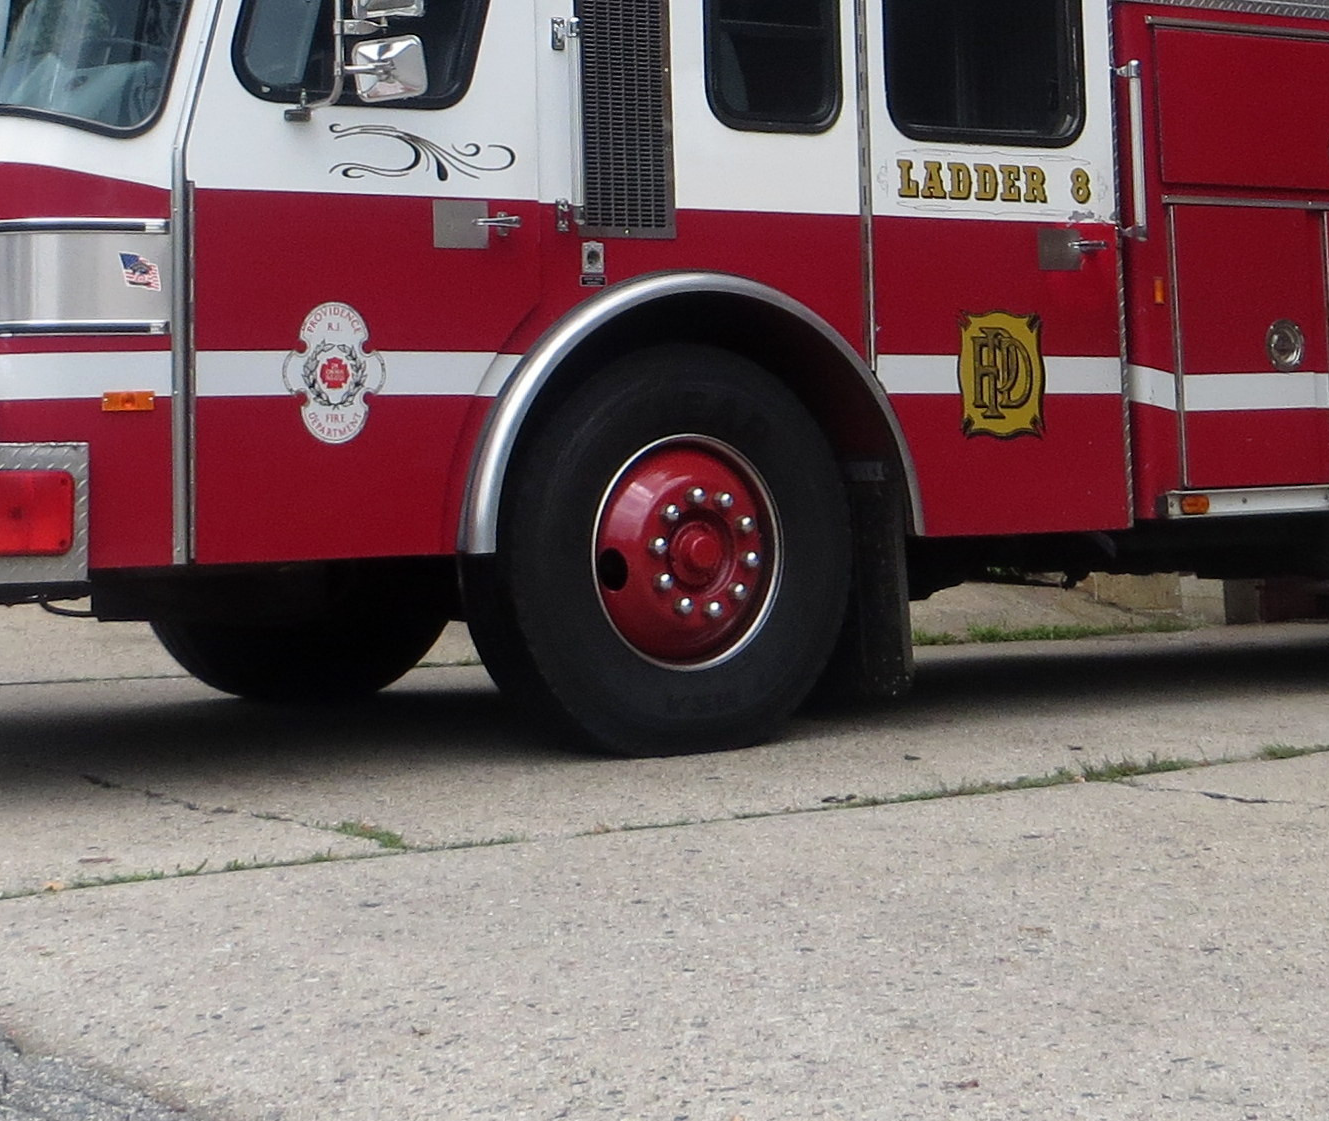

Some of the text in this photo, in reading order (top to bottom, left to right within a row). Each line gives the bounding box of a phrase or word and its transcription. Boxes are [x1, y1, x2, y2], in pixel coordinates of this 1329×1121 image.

[896, 159, 1091, 203] LADDER 8
[306, 306, 363, 335] PROVIDENCE
[308, 411, 363, 438] DEPARTMENT
[326, 414, 345, 423] FIRE
